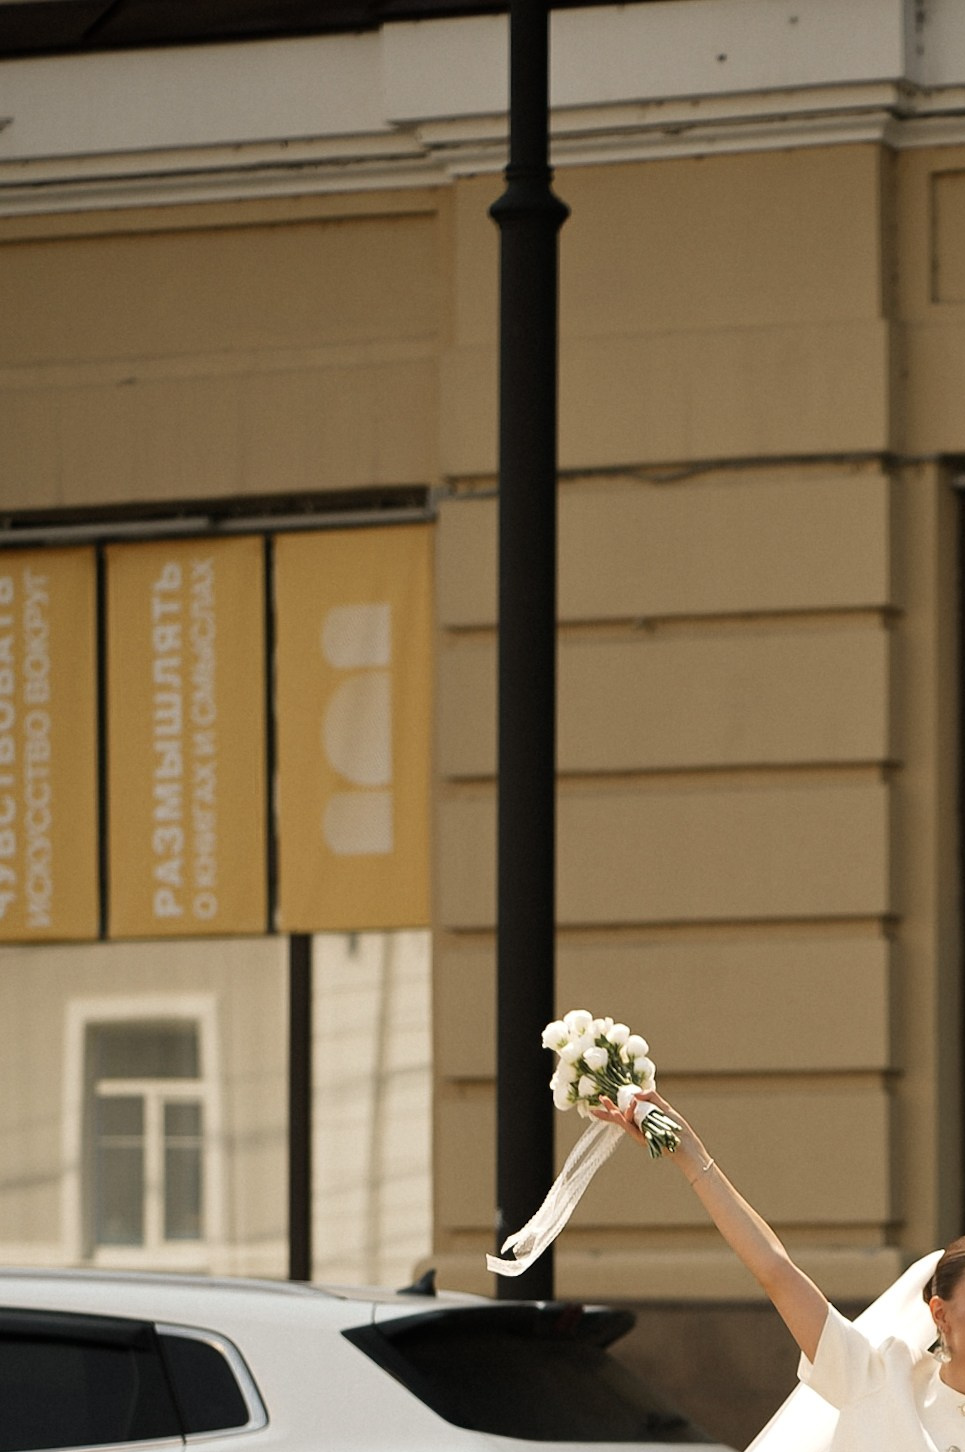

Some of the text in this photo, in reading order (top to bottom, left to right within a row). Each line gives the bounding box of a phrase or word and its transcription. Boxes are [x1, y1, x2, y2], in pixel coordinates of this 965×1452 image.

[23, 565, 52, 929] ИСКУССТВО ВОКРУГ
[151, 561, 185, 919] РАЗМЫШЛЯТЬ
[191, 556, 218, 919] О КНИГАХ И СМЫСЛАХ
